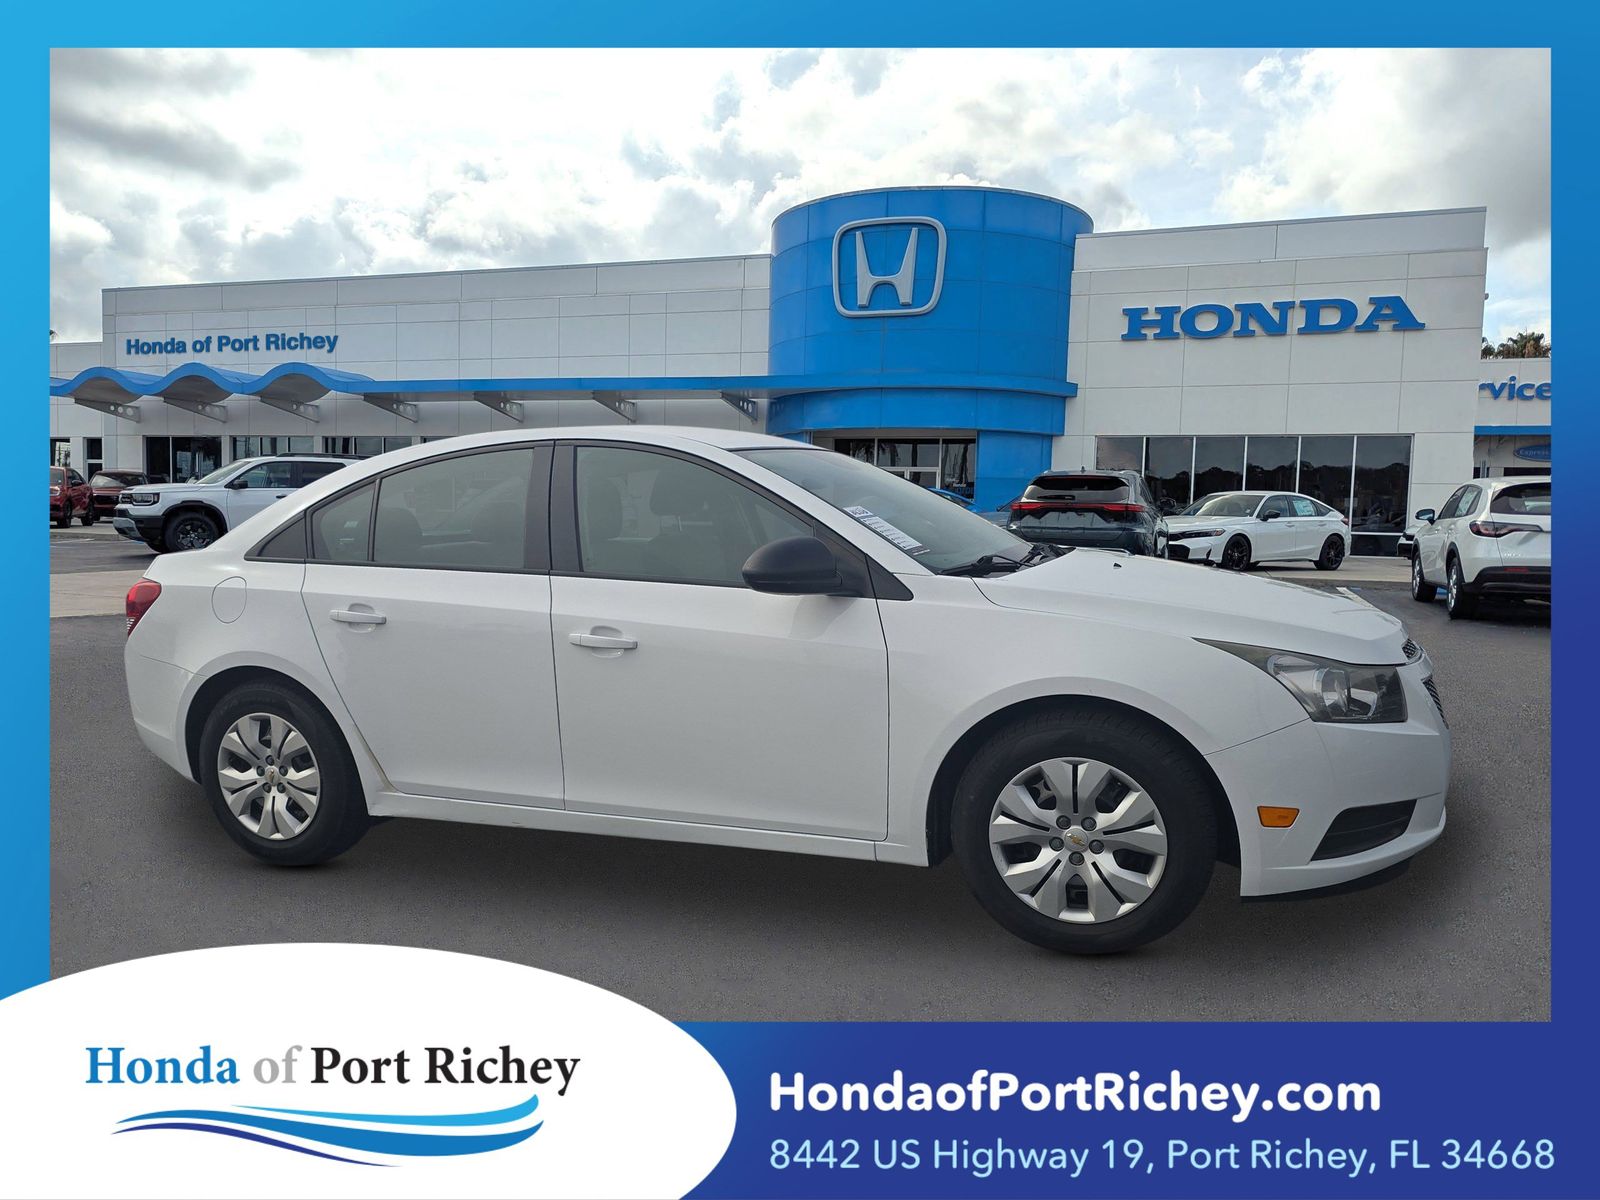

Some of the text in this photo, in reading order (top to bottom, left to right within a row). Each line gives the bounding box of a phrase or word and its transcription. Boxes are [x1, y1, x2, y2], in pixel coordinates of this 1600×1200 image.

[1121, 295, 1424, 340] HONDA
[126, 332, 338, 355] Honda of Port Richey
